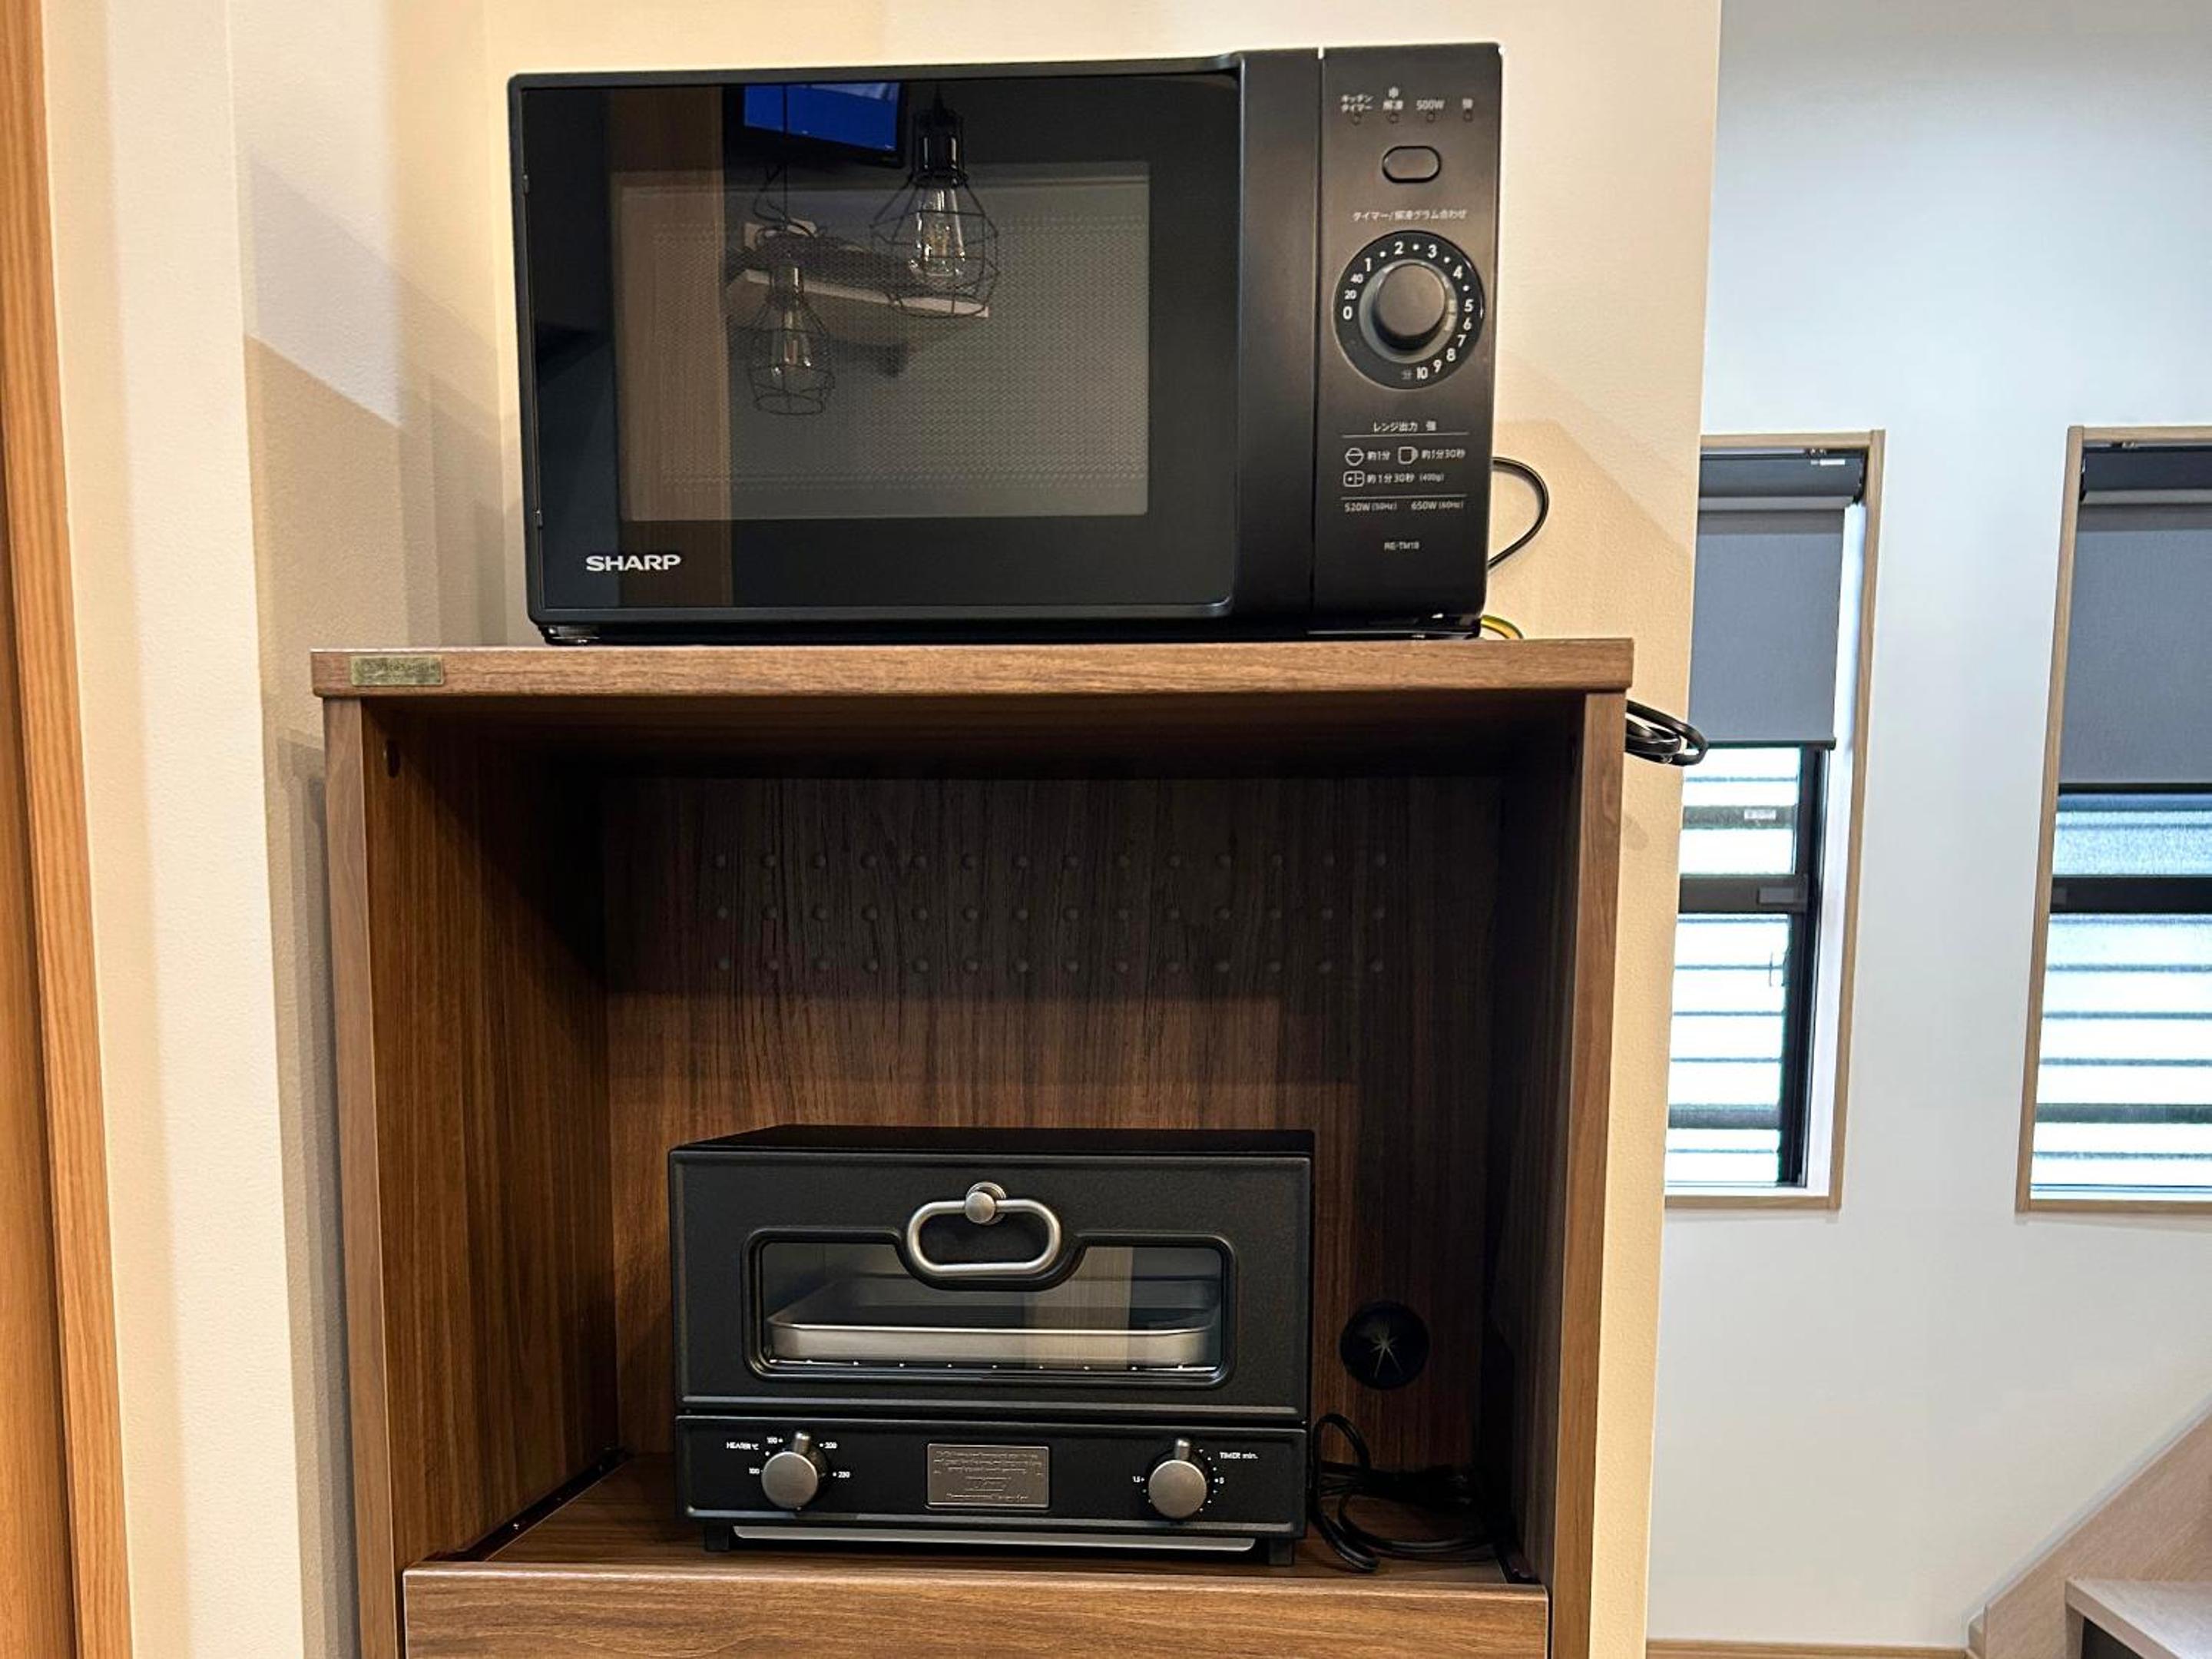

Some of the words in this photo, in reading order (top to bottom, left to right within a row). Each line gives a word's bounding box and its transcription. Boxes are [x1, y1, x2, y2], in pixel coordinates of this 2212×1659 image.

[1394, 242, 1403, 254] 2
[1428, 244, 1437, 258] 3
[1365, 258, 1371, 271] 1
[1351, 273, 1363, 283] 40
[1453, 265, 1462, 279] 4
[1345, 290, 1356, 300] 20
[1465, 299, 1474, 312] 5
[1343, 306, 1353, 320] 0
[1463, 319, 1472, 330] 6
[1458, 334, 1466, 347] 7
[1446, 348, 1455, 361] 8
[1433, 359, 1442, 373] 9
[1416, 367, 1428, 379] 10
[1373, 421, 1418, 432] レンジ出力
[1367, 450, 1391, 461] 約1分
[1345, 502, 1370, 513] 520W
[1411, 501, 1437, 511] 650W
[585, 553, 681, 571] SHARP
